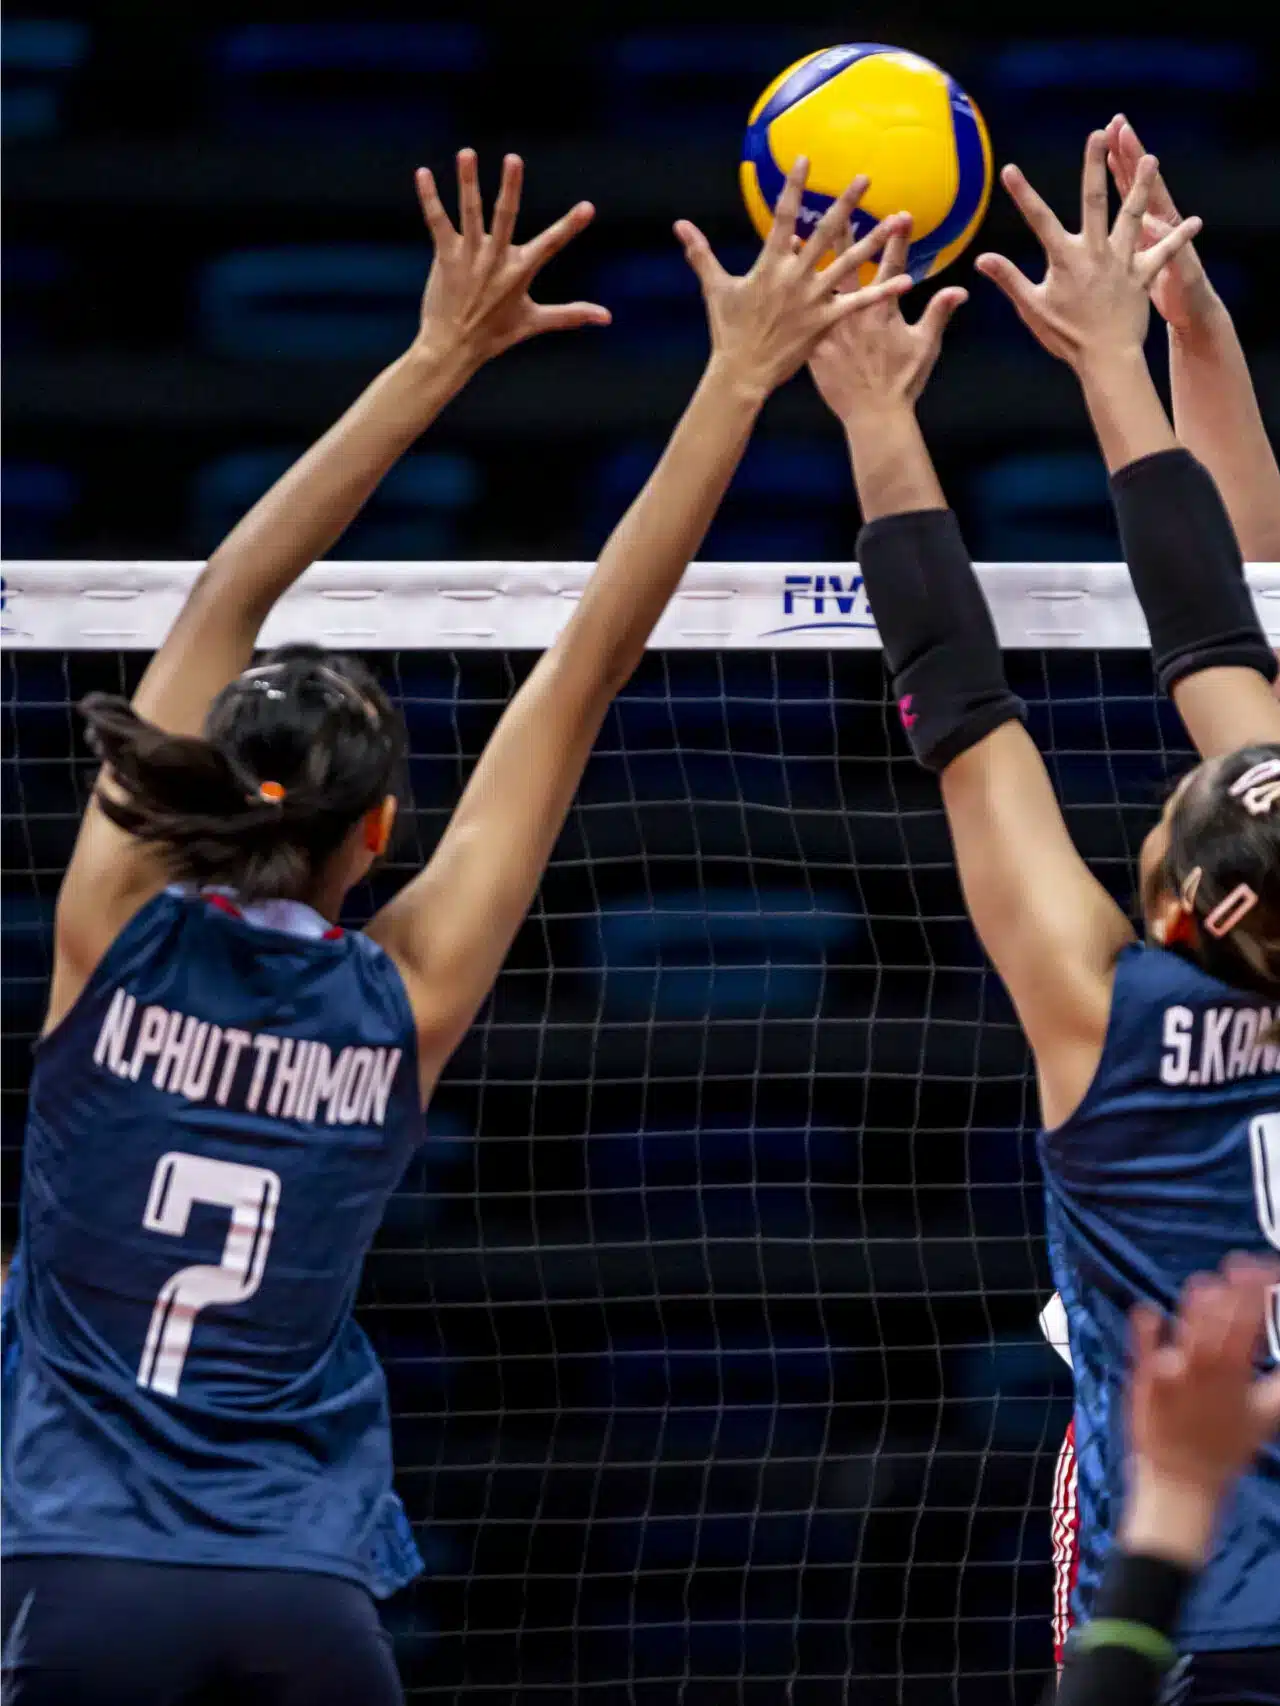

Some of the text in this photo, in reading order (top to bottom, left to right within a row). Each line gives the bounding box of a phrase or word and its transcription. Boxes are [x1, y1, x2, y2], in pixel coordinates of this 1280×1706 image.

[784, 575, 873, 614] FIV
[93, 987, 401, 1127] N.PHUTTHIMON
[136, 1150, 281, 1398] 7
